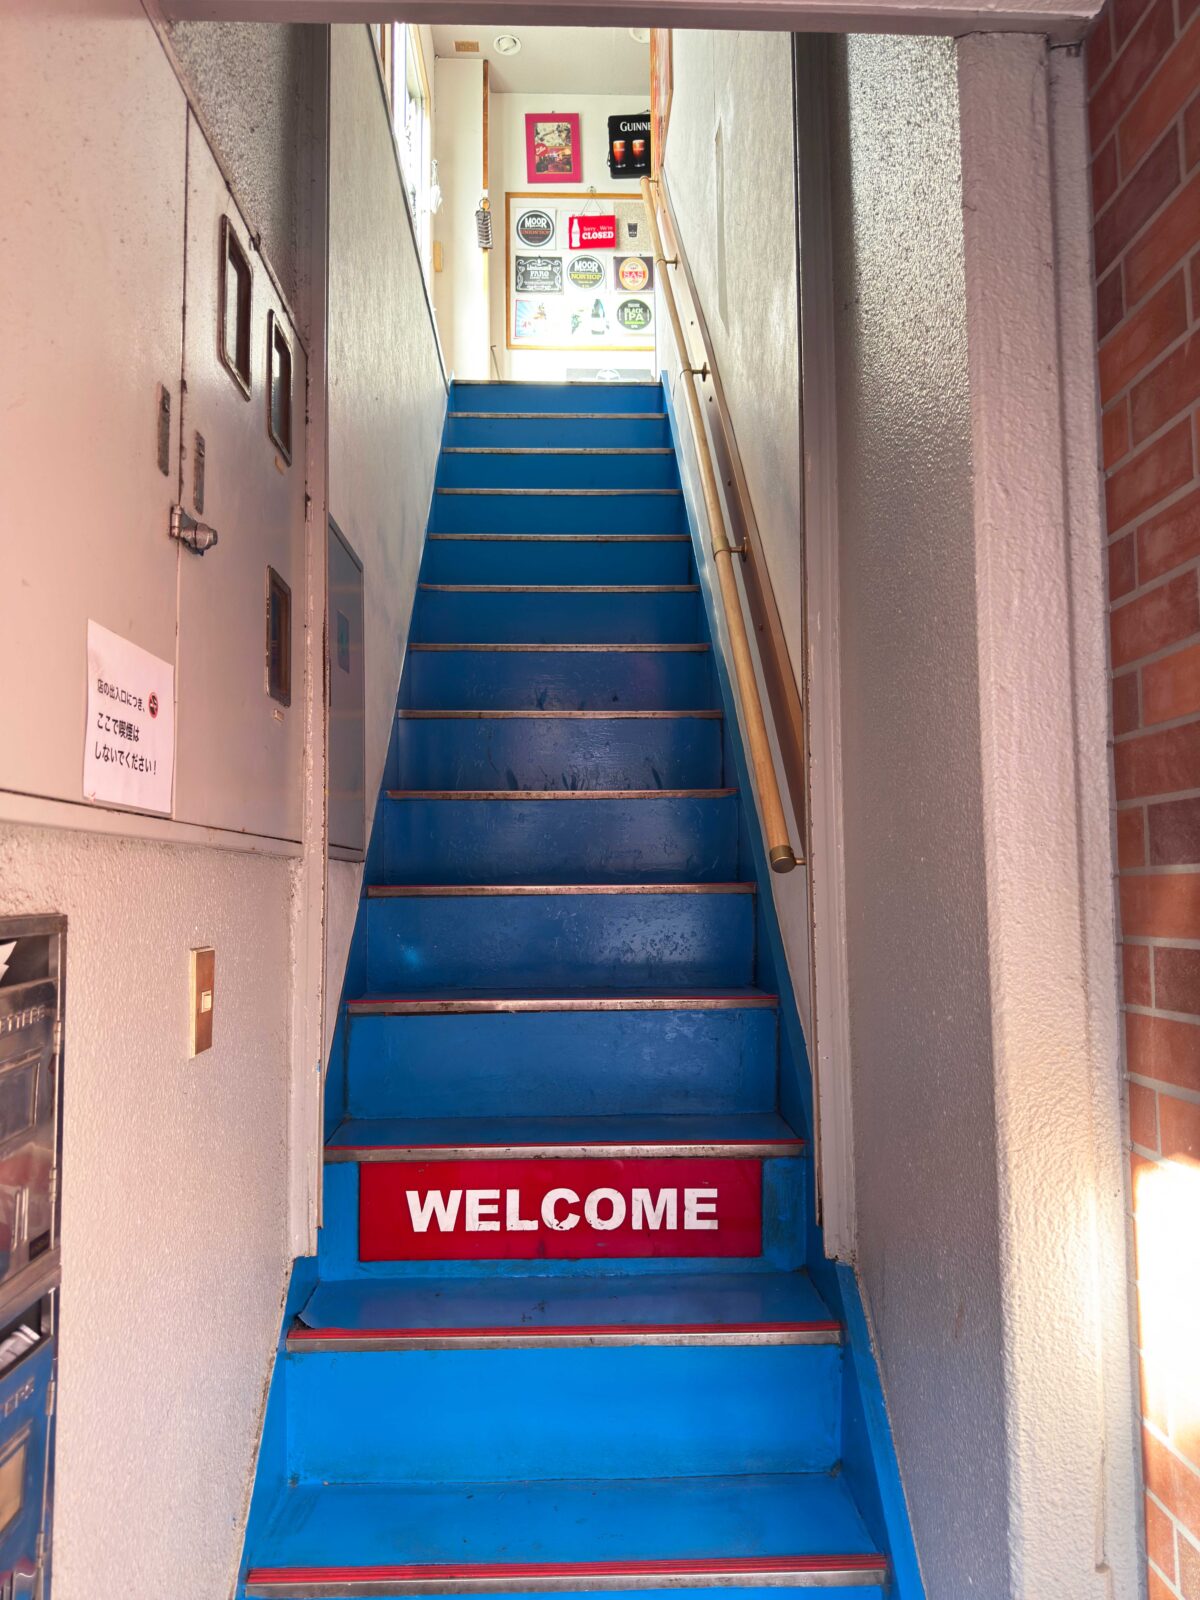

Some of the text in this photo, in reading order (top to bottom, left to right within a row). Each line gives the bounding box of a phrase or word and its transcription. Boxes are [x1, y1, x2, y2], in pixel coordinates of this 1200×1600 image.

[524, 217, 548, 229] MOOR
[582, 231, 614, 240] CLOSED
[574, 260, 599, 272] MOOR
[624, 271, 644, 279] SAS
[624, 313, 645, 321] IPA
[97, 678, 145, 712] 店の出入口につき、
[97, 712, 140, 743] ここで喫煙は
[405, 1187, 719, 1233] WELCOME
